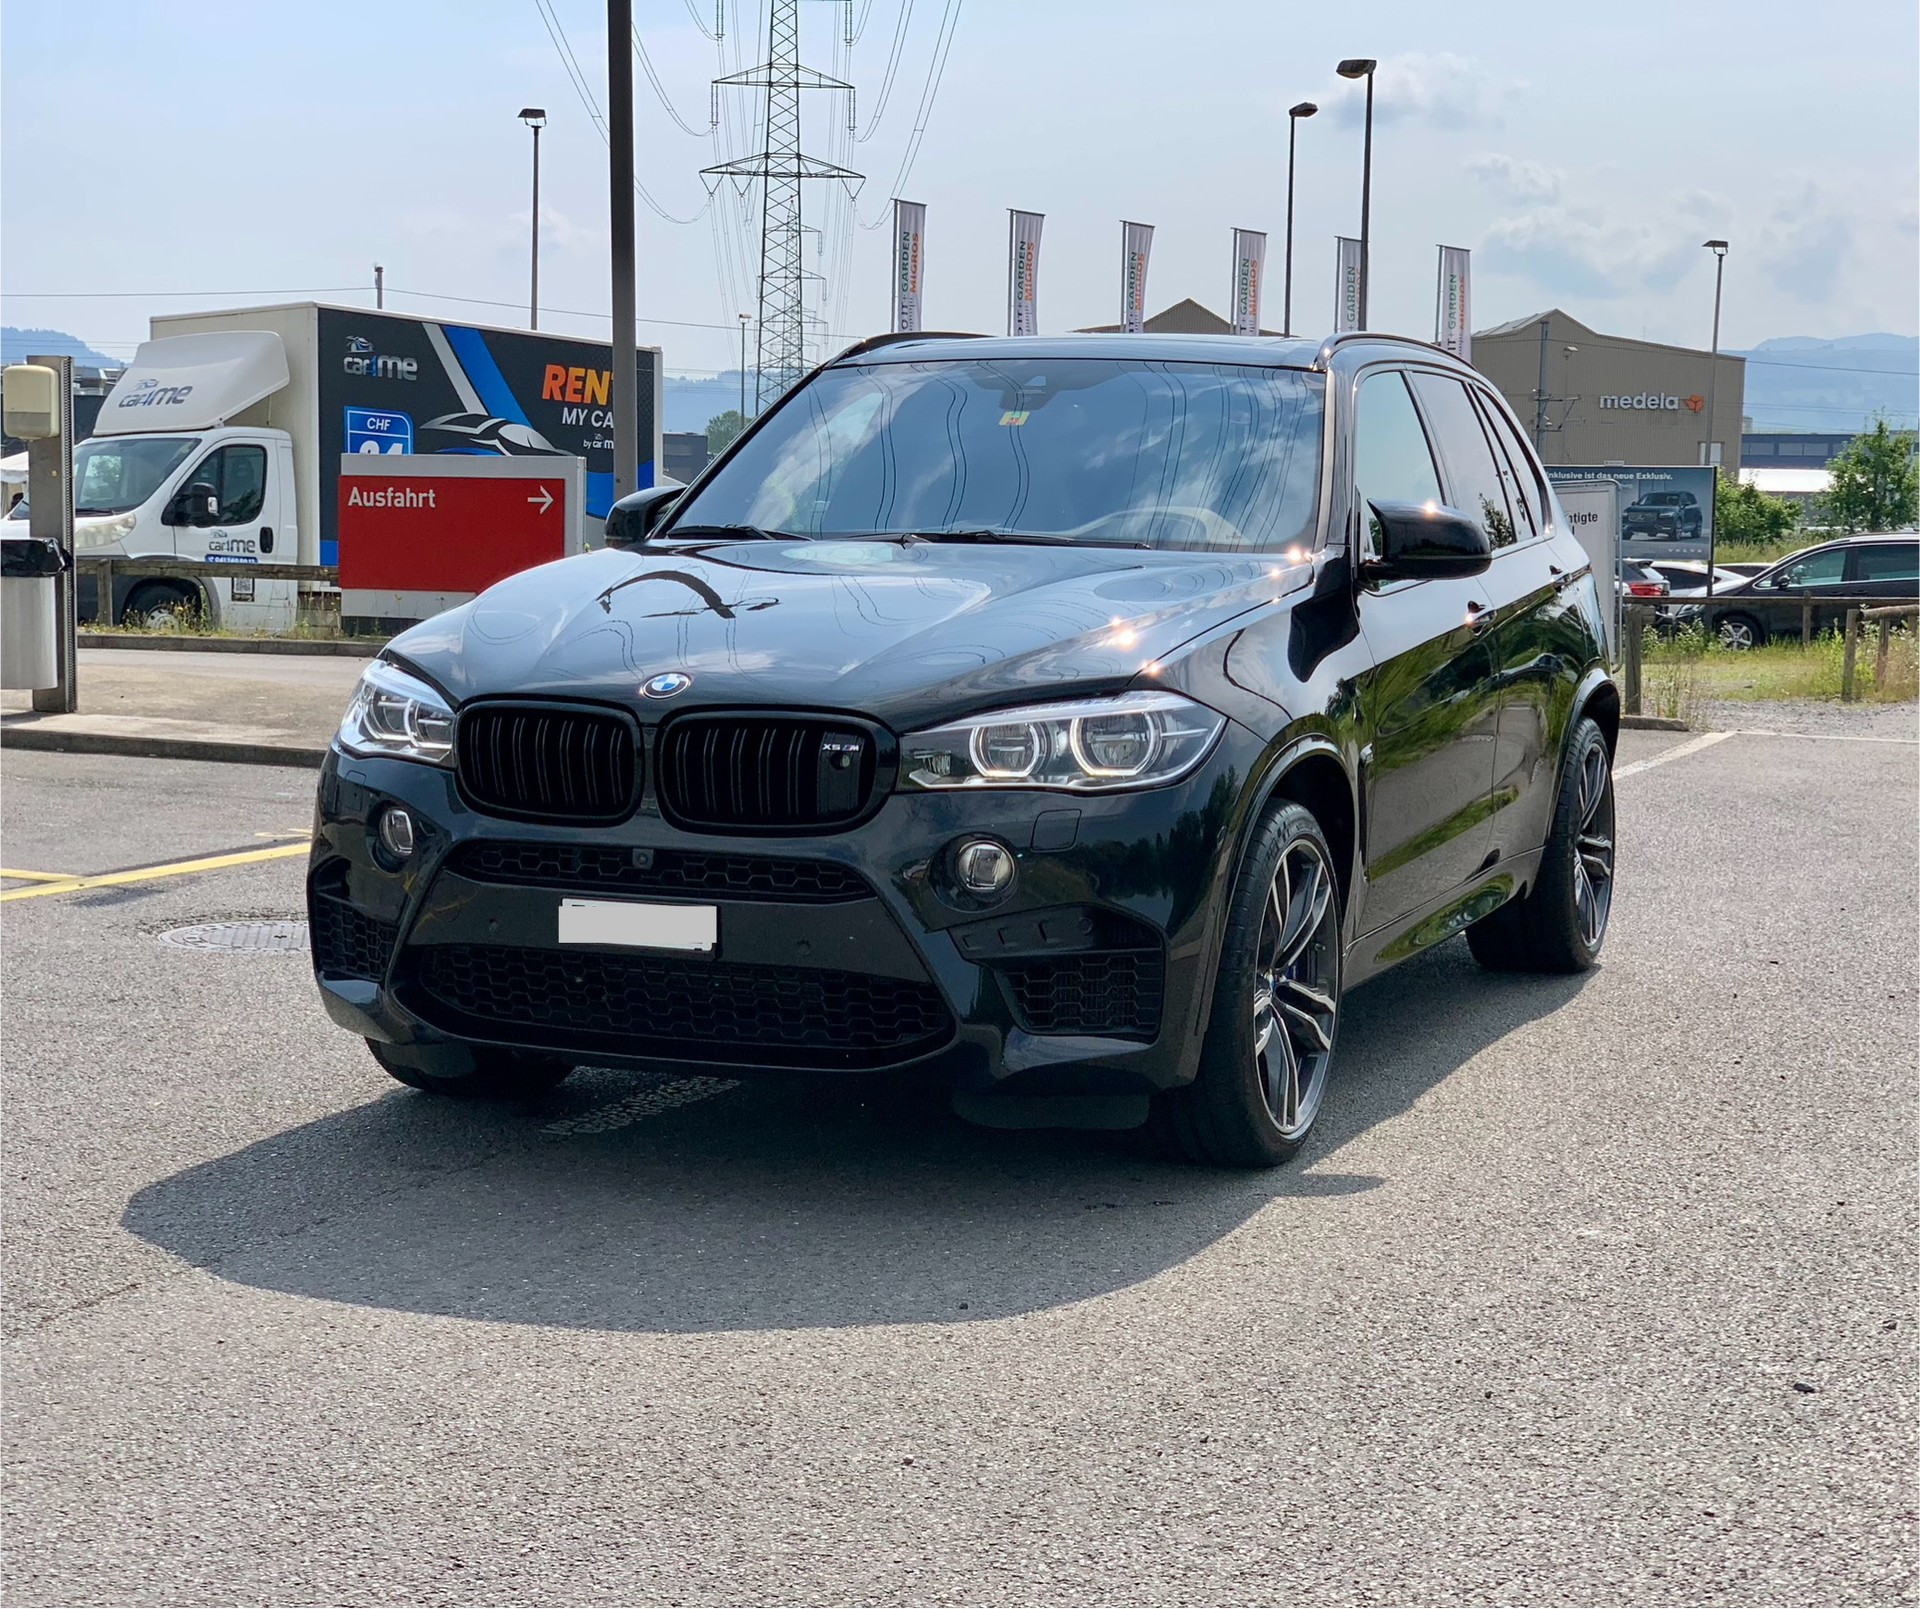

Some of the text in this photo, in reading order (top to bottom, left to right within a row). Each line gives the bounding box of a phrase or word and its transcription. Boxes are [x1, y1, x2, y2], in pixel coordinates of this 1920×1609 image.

[901, 231, 910, 293] GARDEN
[909, 232, 919, 294] MIGROS
[1017, 240, 1026, 301] GARDEN
[1024, 242, 1035, 302] MIGROS
[1128, 251, 1137, 310] GARDEN
[1135, 253, 1144, 311] MIGROS
[1239, 258, 1249, 316] GARDEN
[1248, 259, 1258, 318] MIGROS
[901, 302, 909, 315] IT
[1346, 265, 1355, 322] GARDEN
[1447, 273, 1457, 330] GARDEN
[1447, 338, 1456, 351] IT
[542, 364, 613, 405] REN
[1600, 392, 1679, 409] medela
[367, 417, 391, 431] CHF
[562, 407, 614, 428] MY CA
[583, 439, 592, 449] by
[348, 486, 436, 508] Ausfahrt
[1584, 472, 1595, 480] ist
[1596, 472, 1612, 480] das
[1636, 473, 1673, 481] Exklusiv.
